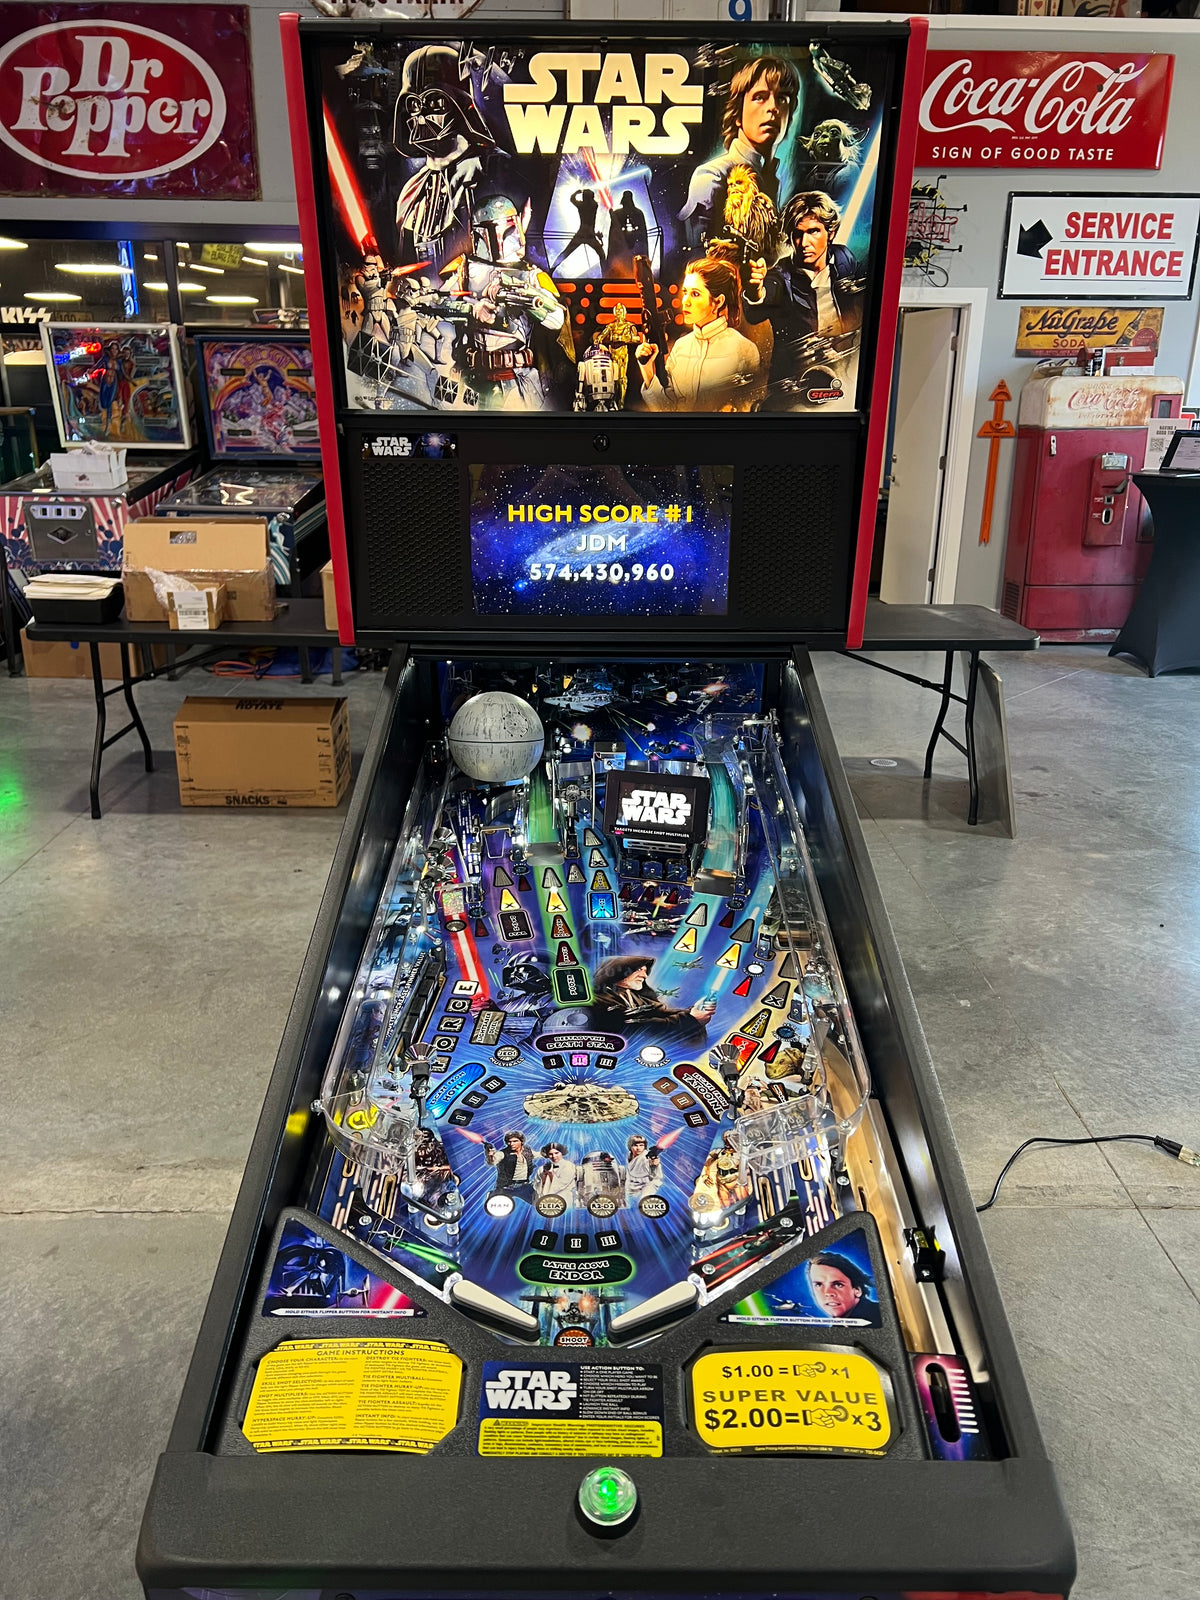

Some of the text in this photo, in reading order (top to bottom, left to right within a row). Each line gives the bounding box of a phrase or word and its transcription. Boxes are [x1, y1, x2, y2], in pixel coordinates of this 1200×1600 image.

[70, 35, 163, 94] Dr
[503, 52, 704, 104] STAR
[919, 58, 1150, 134] Coca-Cola
[10, 66, 211, 157] Pepper
[504, 104, 703, 154] WARS
[932, 147, 1114, 160] SIGN OF GOOD TASTE
[1064, 212, 1175, 240] SERVICE
[1044, 249, 1184, 276] ENTRANCE
[1, 307, 52, 324] KISS
[1026, 309, 1121, 338] NuGrape
[1053, 339, 1086, 348] SODA
[372, 437, 412, 447] STAR
[372, 446, 412, 456] WARS
[508, 504, 693, 523] HIGH SCORE #1
[576, 535, 627, 552] JDM
[530, 563, 674, 582] 574,430,960
[225, 796, 270, 805] SNACKS
[622, 790, 691, 810] STAR
[622, 804, 691, 825] WARS
[488, 1020, 498, 1035] DUEL
[546, 1041, 614, 1050] DEATH STAR
[490, 1057, 525, 1067] MULTIBALL
[634, 1056, 671, 1068] MULTIBALL
[692, 1072, 716, 1091] ESCAPE
[443, 1080, 466, 1102] HOTH
[682, 1072, 724, 1115] TATOOINE
[540, 1235, 548, 1245] I
[570, 1238, 582, 1248] II
[600, 1235, 617, 1246] III
[543, 1260, 610, 1270] BATTLE ABOVE
[549, 1270, 604, 1280] ENDOR
[486, 1370, 577, 1390] STAR
[722, 1365, 773, 1379] $1.00
[831, 1367, 850, 1379] x1
[486, 1389, 577, 1410] WARS
[702, 1390, 878, 1405] SUPER VALUE
[704, 1408, 882, 1432] $2.00= x3
